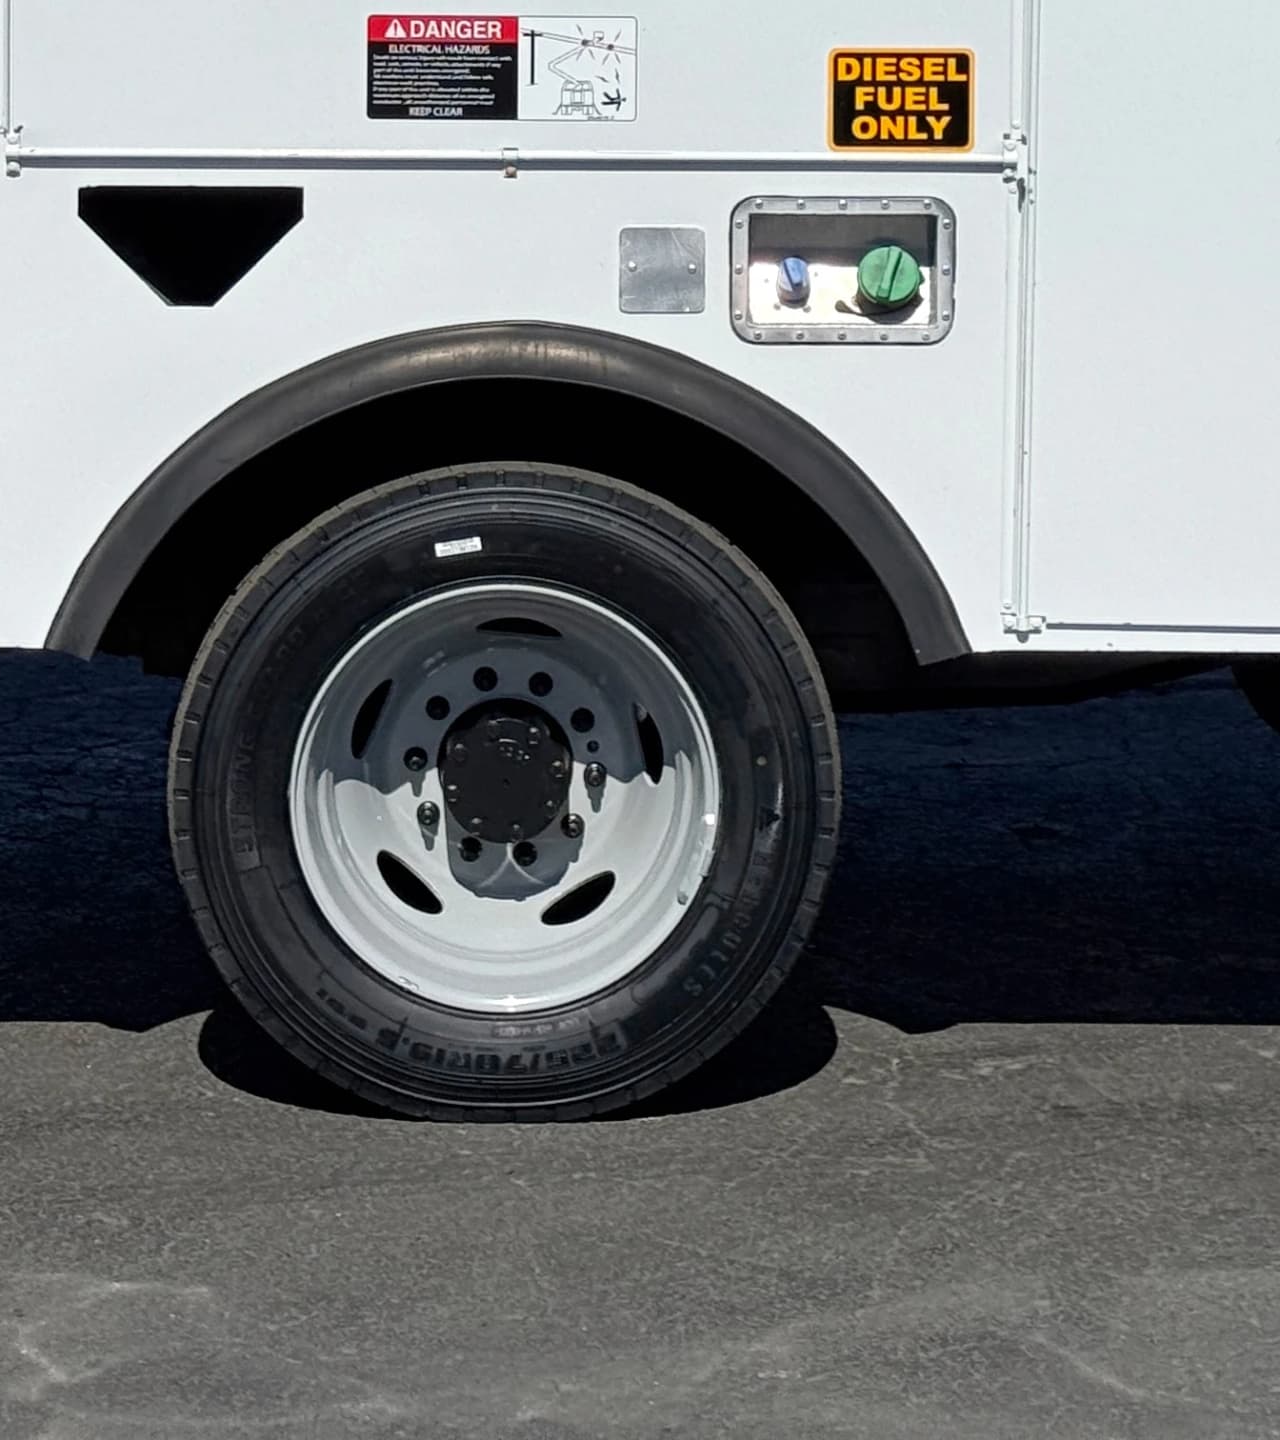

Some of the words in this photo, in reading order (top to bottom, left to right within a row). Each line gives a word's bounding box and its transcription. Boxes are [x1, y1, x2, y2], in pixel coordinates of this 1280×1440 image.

[409, 20, 503, 39] DANGER
[388, 44, 443, 54] ELECTRICAL
[444, 44, 491, 55] HAZARDS
[836, 57, 968, 82] DIESEL
[854, 86, 950, 111] FUEL
[408, 106, 433, 117] KEEP
[433, 106, 464, 117] CLEAR
[851, 115, 952, 140] ONLY
